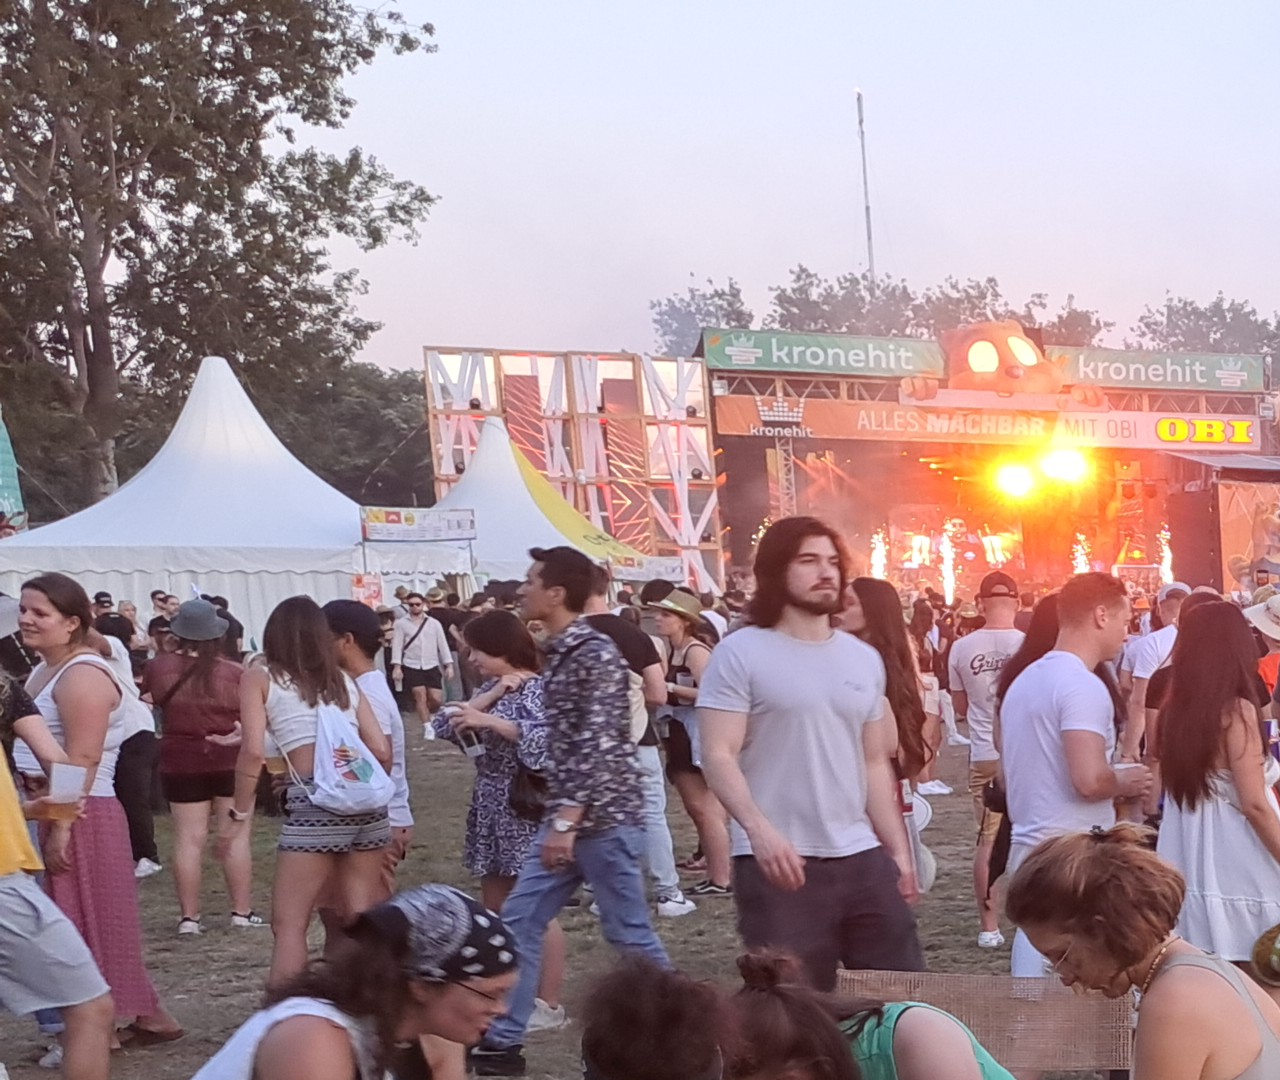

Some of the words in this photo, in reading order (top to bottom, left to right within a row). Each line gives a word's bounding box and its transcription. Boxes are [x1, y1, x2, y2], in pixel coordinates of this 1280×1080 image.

[771, 338, 914, 370] kronehit
[1078, 354, 1207, 383] kronehit
[750, 424, 813, 438] kronehit
[857, 410, 919, 432] ALLES
[926, 412, 1046, 437] MACHBAR
[1064, 418, 1099, 438] MIT
[1107, 419, 1137, 439] OBI
[1156, 417, 1253, 443] OBI
